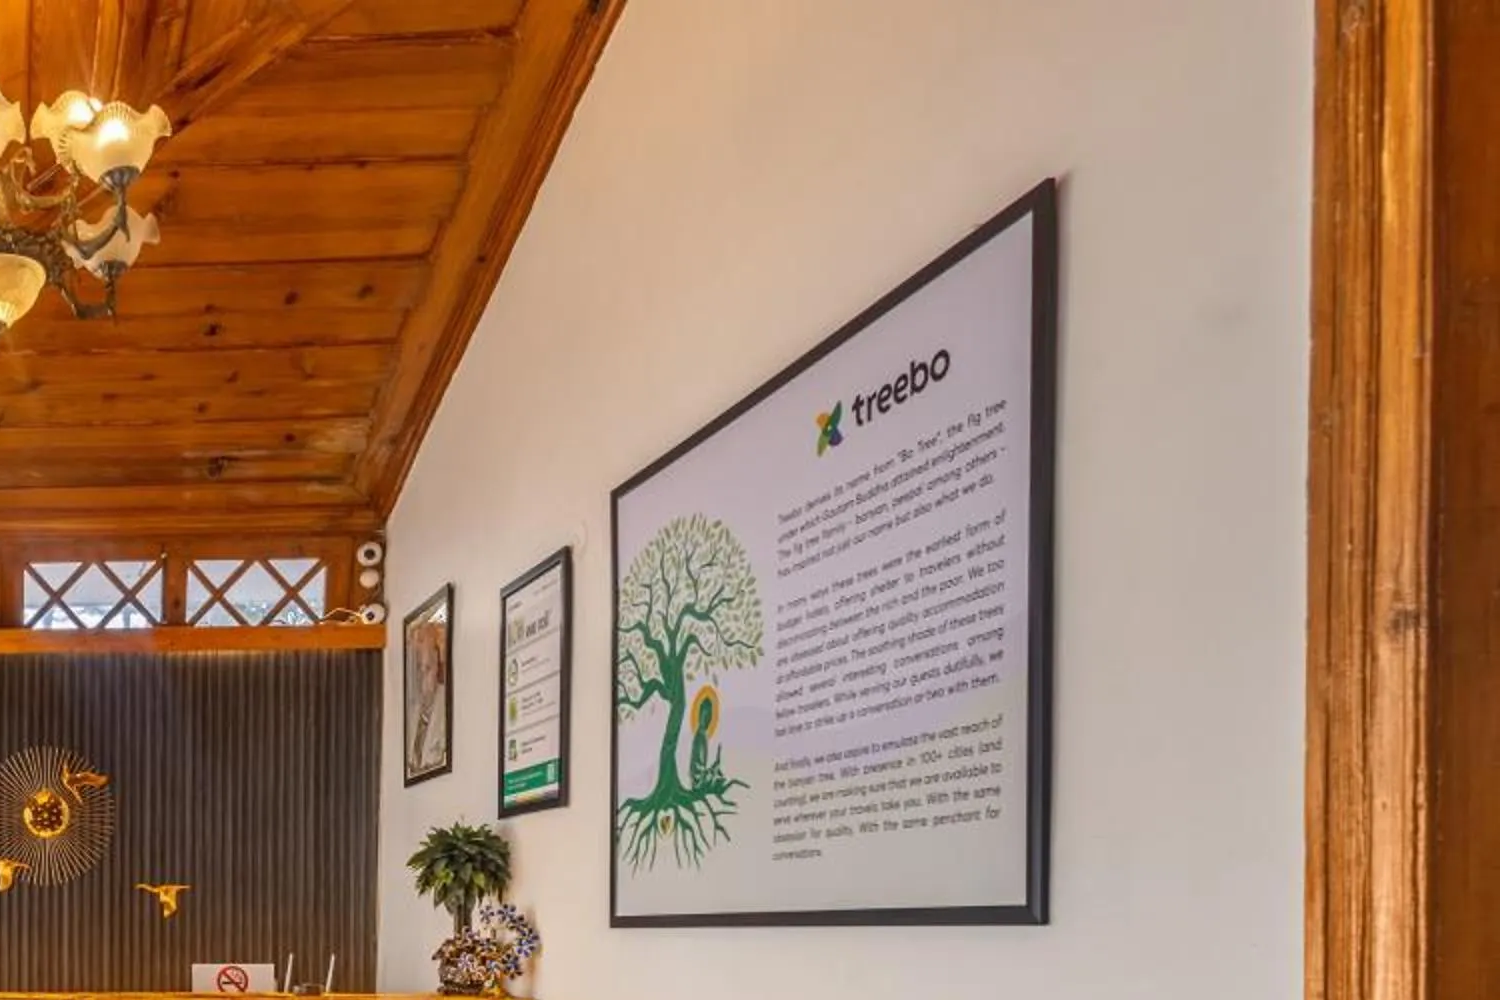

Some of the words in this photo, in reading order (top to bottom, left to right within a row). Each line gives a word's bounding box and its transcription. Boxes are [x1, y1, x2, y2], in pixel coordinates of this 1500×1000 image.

[851, 349, 950, 427] treebo
[947, 421, 963, 438] the
[967, 411, 980, 428] fig
[985, 398, 1006, 418] tree
[965, 448, 996, 472] others
[934, 486, 959, 508] what
[962, 480, 976, 496] we
[906, 545, 922, 561] the
[965, 517, 991, 537] form
[995, 507, 1005, 525] of
[966, 532, 1004, 559] without
[921, 582, 936, 597] the
[967, 564, 984, 580] We
[987, 558, 1004, 573] too
[967, 625, 1003, 646] among
[989, 647, 1003, 661] we
[947, 676, 968, 693] with
[991, 713, 1002, 728] of
[920, 746, 942, 763] 100+
[948, 742, 974, 758] cities
[923, 772, 940, 783] are
[942, 761, 988, 780] available
[990, 760, 1001, 773] to
[952, 787, 969, 801] the
[983, 804, 1000, 818] for
